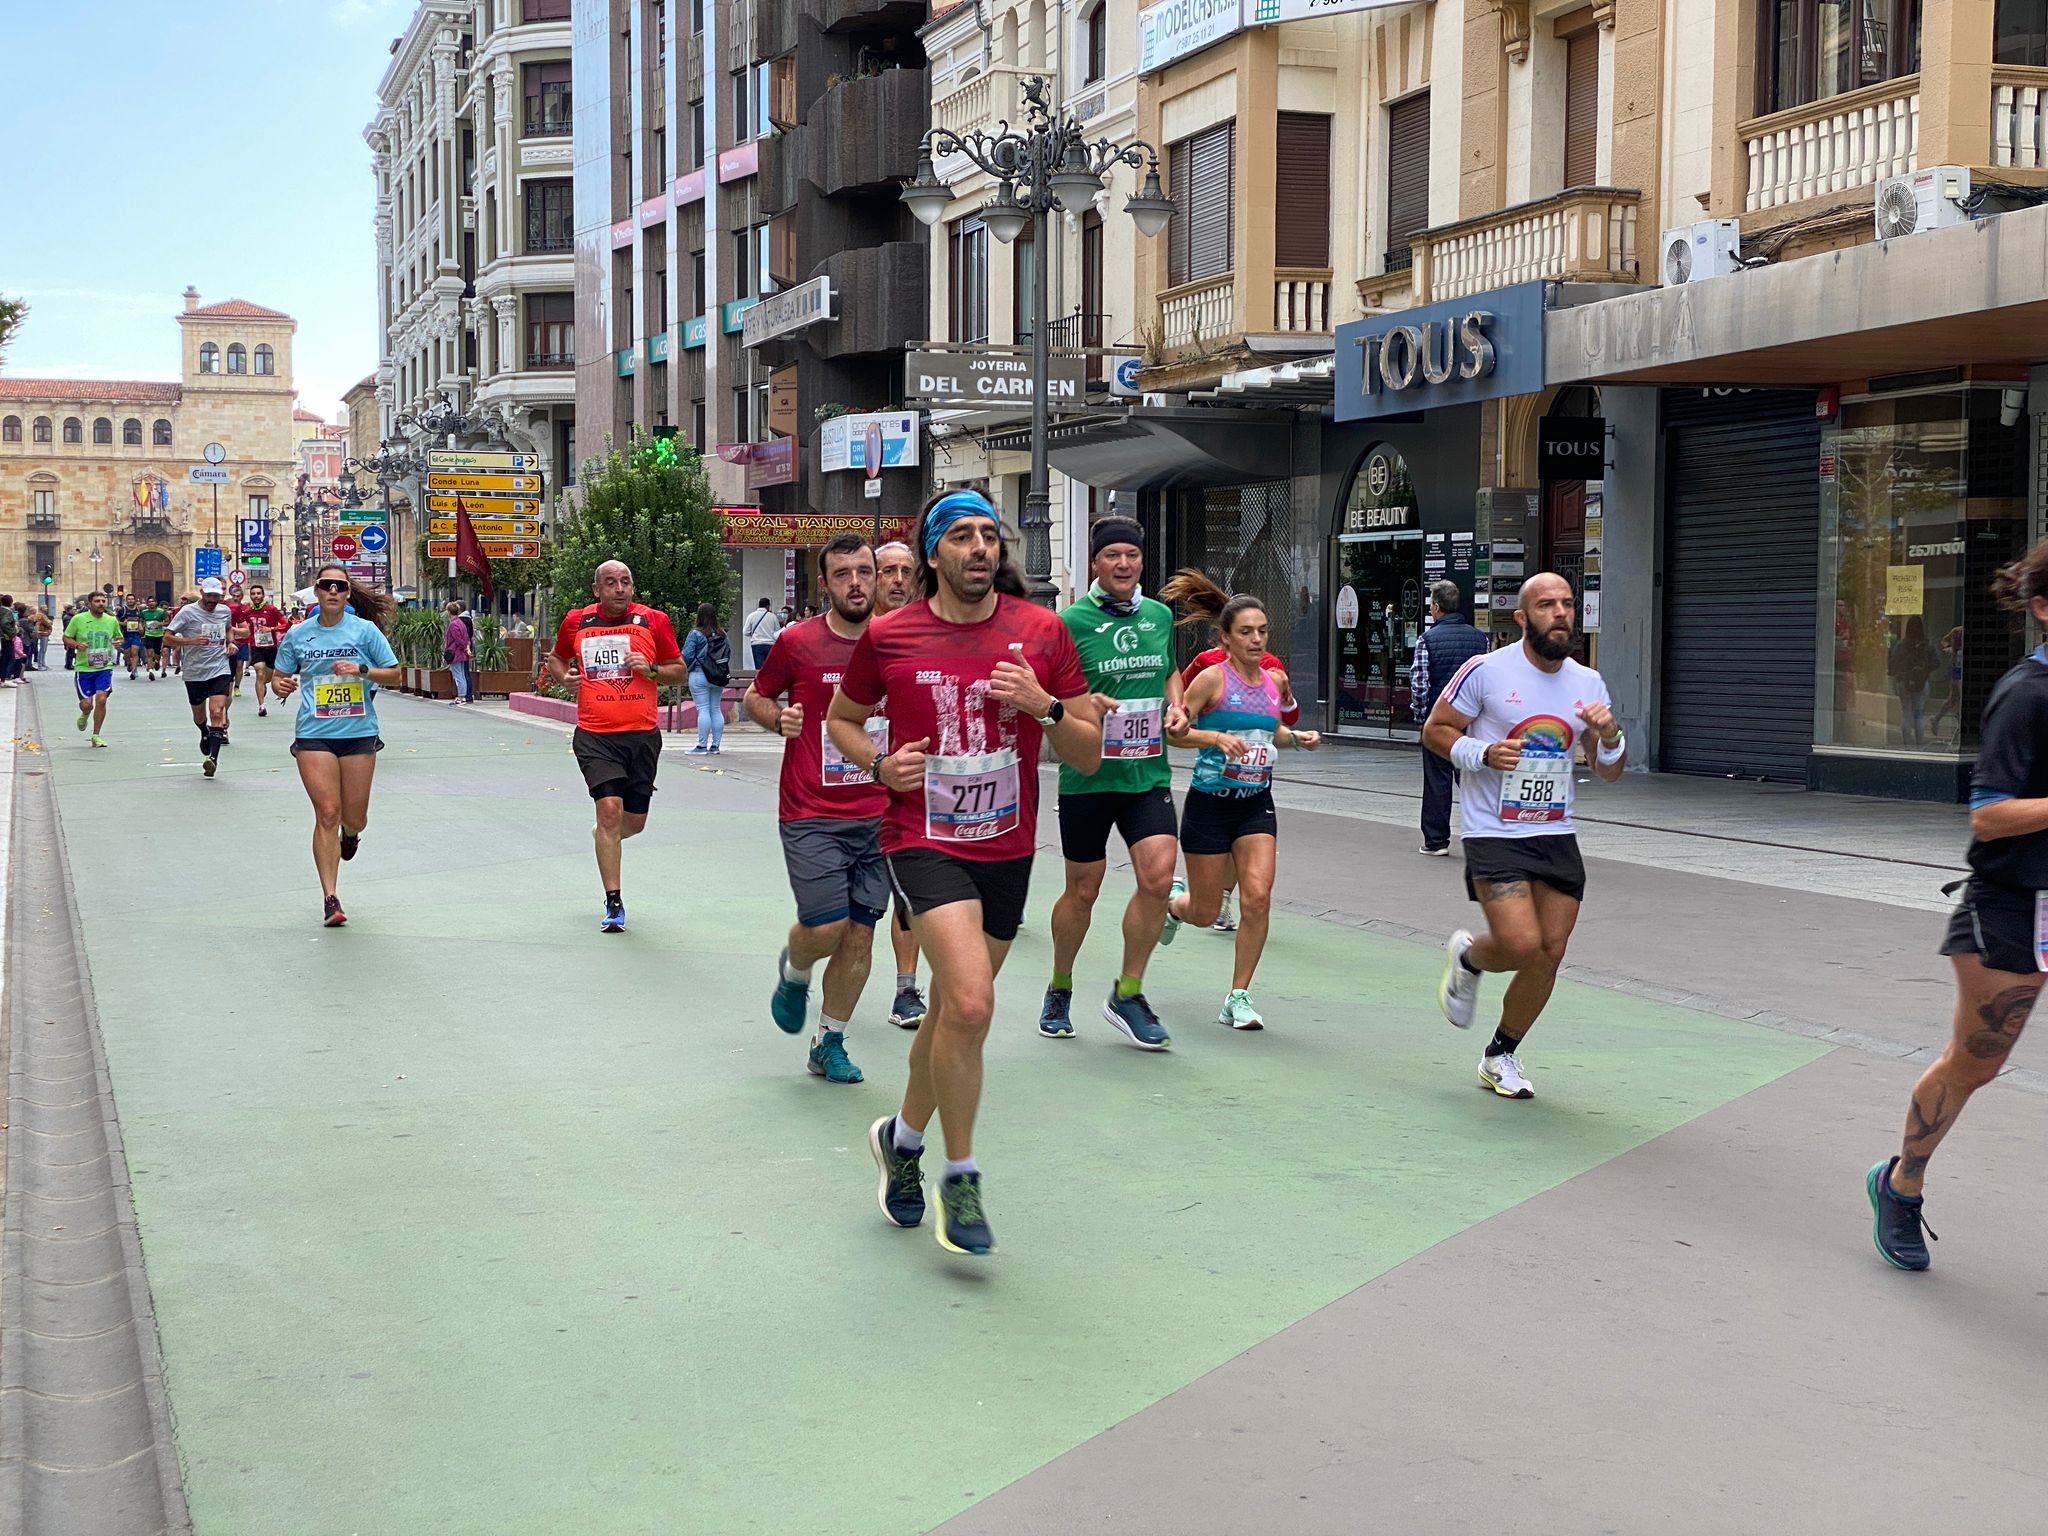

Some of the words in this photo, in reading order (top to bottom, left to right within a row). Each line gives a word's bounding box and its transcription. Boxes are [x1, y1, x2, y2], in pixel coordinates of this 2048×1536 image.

[1353, 310, 1497, 396] TOUS
[969, 360, 1027, 372] JOYERIA
[919, 374, 964, 393] DEL
[1545, 441, 1600, 456] TOUS
[192, 468, 227, 479] Cámara
[1371, 465, 1385, 485] BE
[431, 478, 457, 486] Conde
[431, 500, 448, 508] Luis
[465, 501, 485, 509] León
[724, 516, 788, 528] ROYAL
[794, 517, 899, 529] TANDOORI
[1350, 510, 1366, 528] BE
[1366, 506, 1409, 527] BEAUTY
[244, 520, 259, 543] P
[333, 543, 355, 551] STOP
[594, 649, 619, 665] 496
[1098, 656, 1128, 673] LEÓN
[1128, 654, 1164, 668] CORRE
[915, 671, 941, 679] 2022
[326, 687, 352, 704] 258
[596, 694, 616, 702] CAJA
[620, 693, 646, 701] RURAL
[1123, 718, 1149, 739] 316
[952, 781, 997, 813] 277
[1520, 779, 1554, 802] 588
